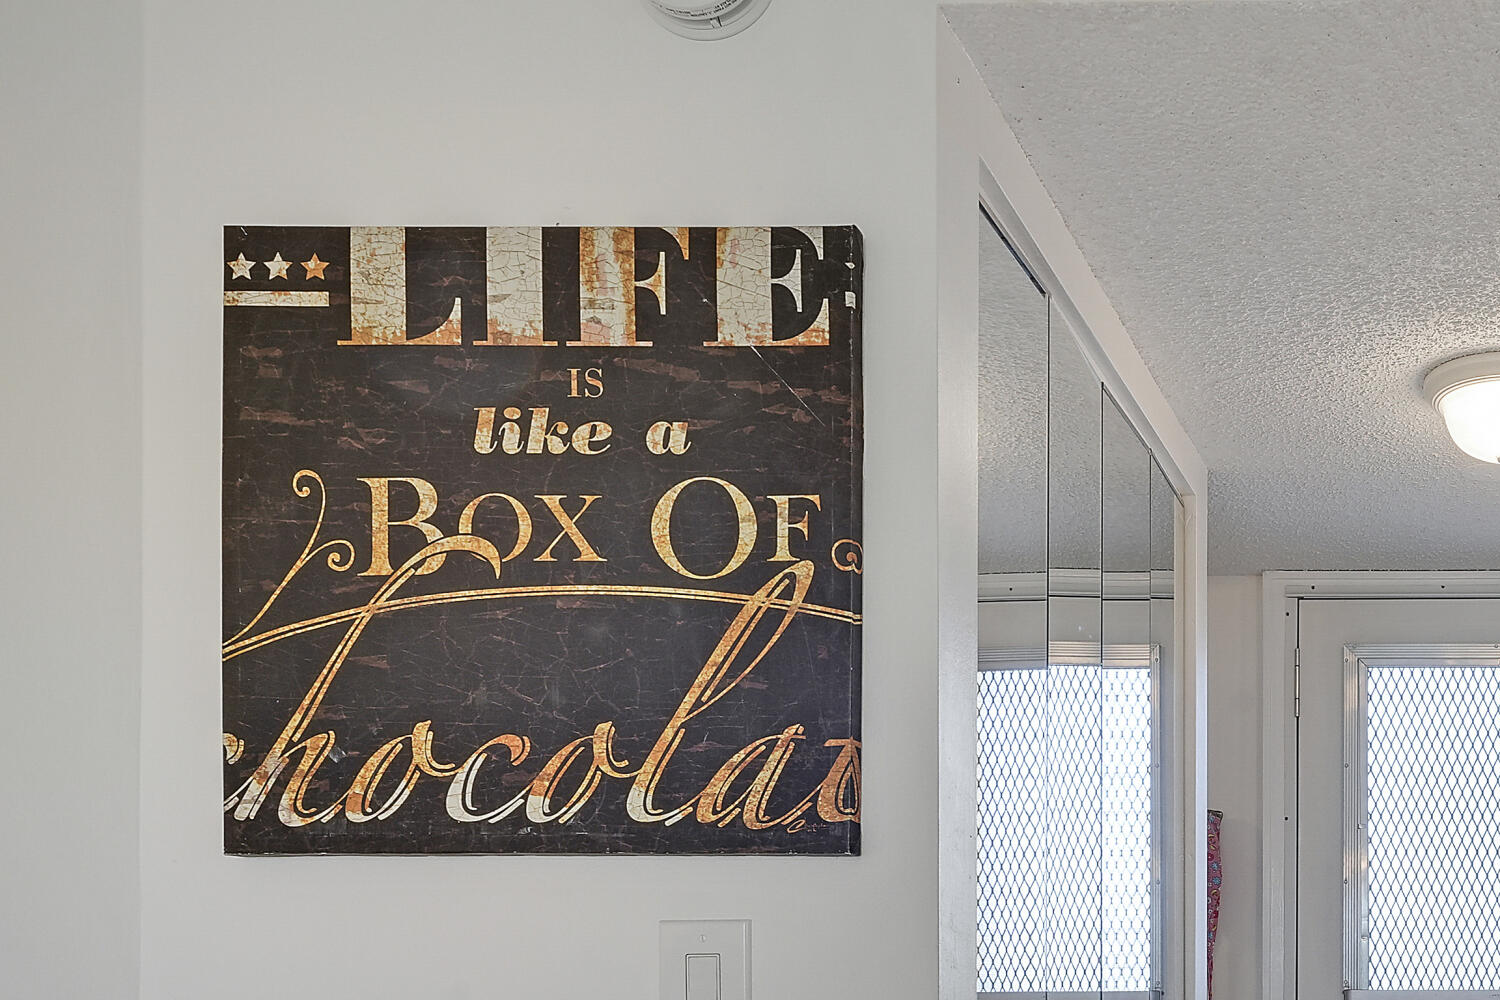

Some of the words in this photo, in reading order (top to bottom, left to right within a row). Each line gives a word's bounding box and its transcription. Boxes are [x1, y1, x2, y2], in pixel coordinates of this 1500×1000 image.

[337, 227, 832, 346] LIFE
[566, 367, 605, 399] IS
[471, 406, 612, 456] like
[644, 419, 692, 456] a
